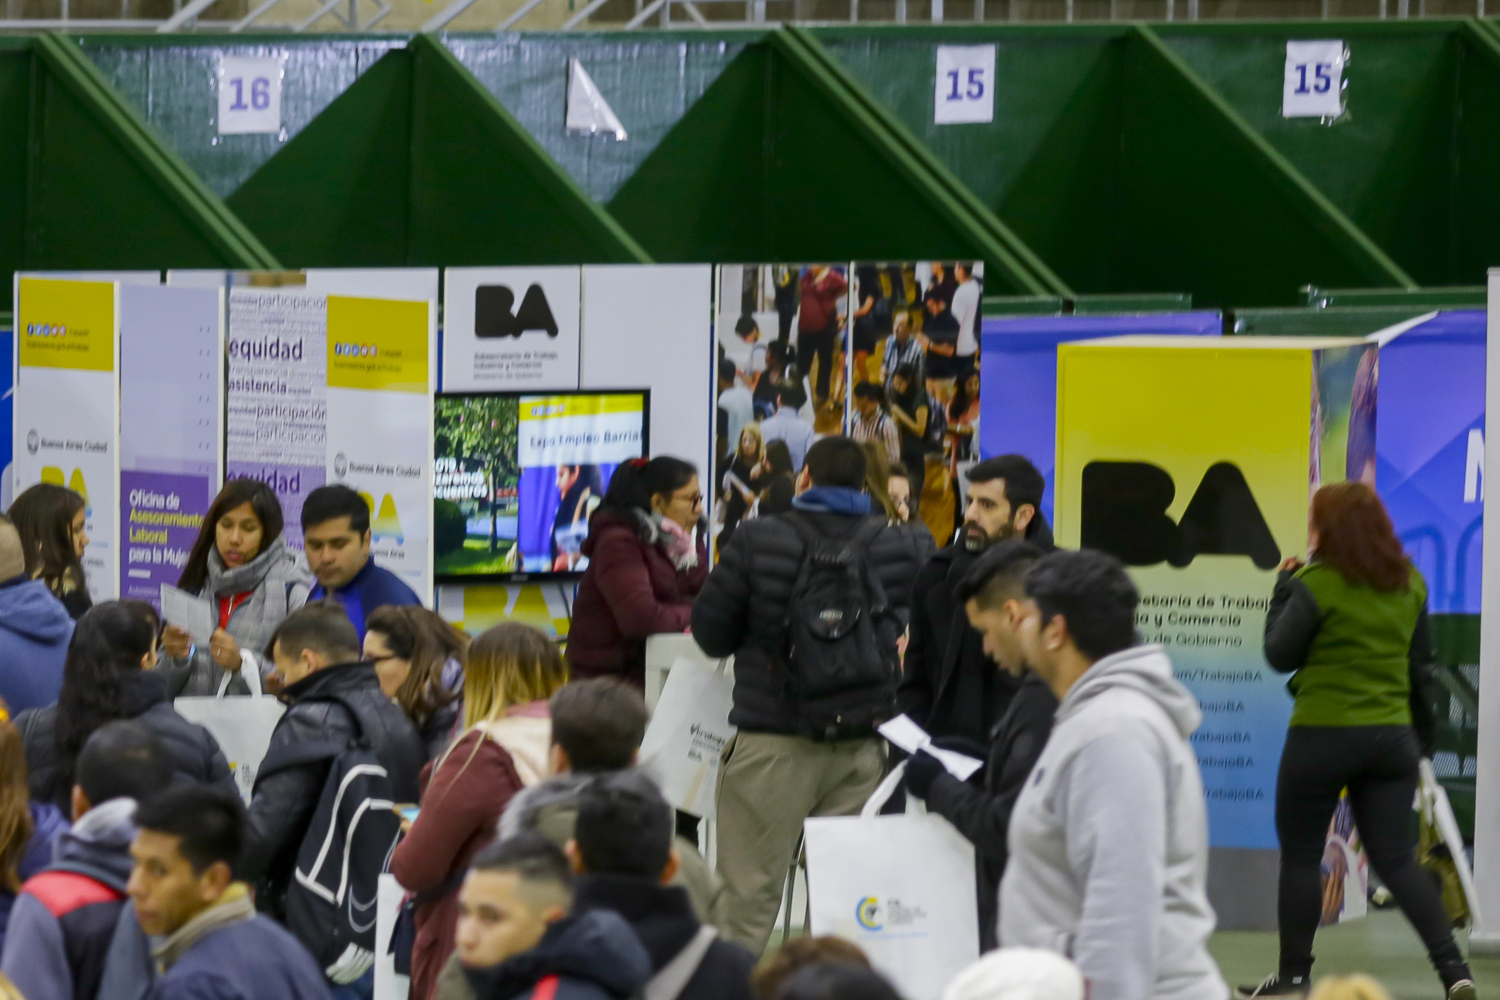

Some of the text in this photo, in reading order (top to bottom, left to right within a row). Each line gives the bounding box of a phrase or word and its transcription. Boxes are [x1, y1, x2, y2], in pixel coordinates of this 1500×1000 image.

[948, 70, 983, 99] 15
[1295, 64, 1330, 93] 15
[231, 79, 269, 109] 16
[475, 283, 559, 338] BA
[229, 335, 303, 363] equidad
[228, 377, 288, 394] asistencia
[129, 488, 180, 510] Oficina de
[1080, 460, 1283, 570] BA
[129, 525, 168, 545] Laboral
[129, 546, 189, 568] para la Muje
[1196, 594, 1215, 609] de
[1221, 595, 1270, 612] Trabaj
[1154, 613, 1163, 628] y
[1168, 611, 1241, 628] Comercio
[1154, 631, 1171, 645] de
[1176, 632, 1243, 648] Gobierno
